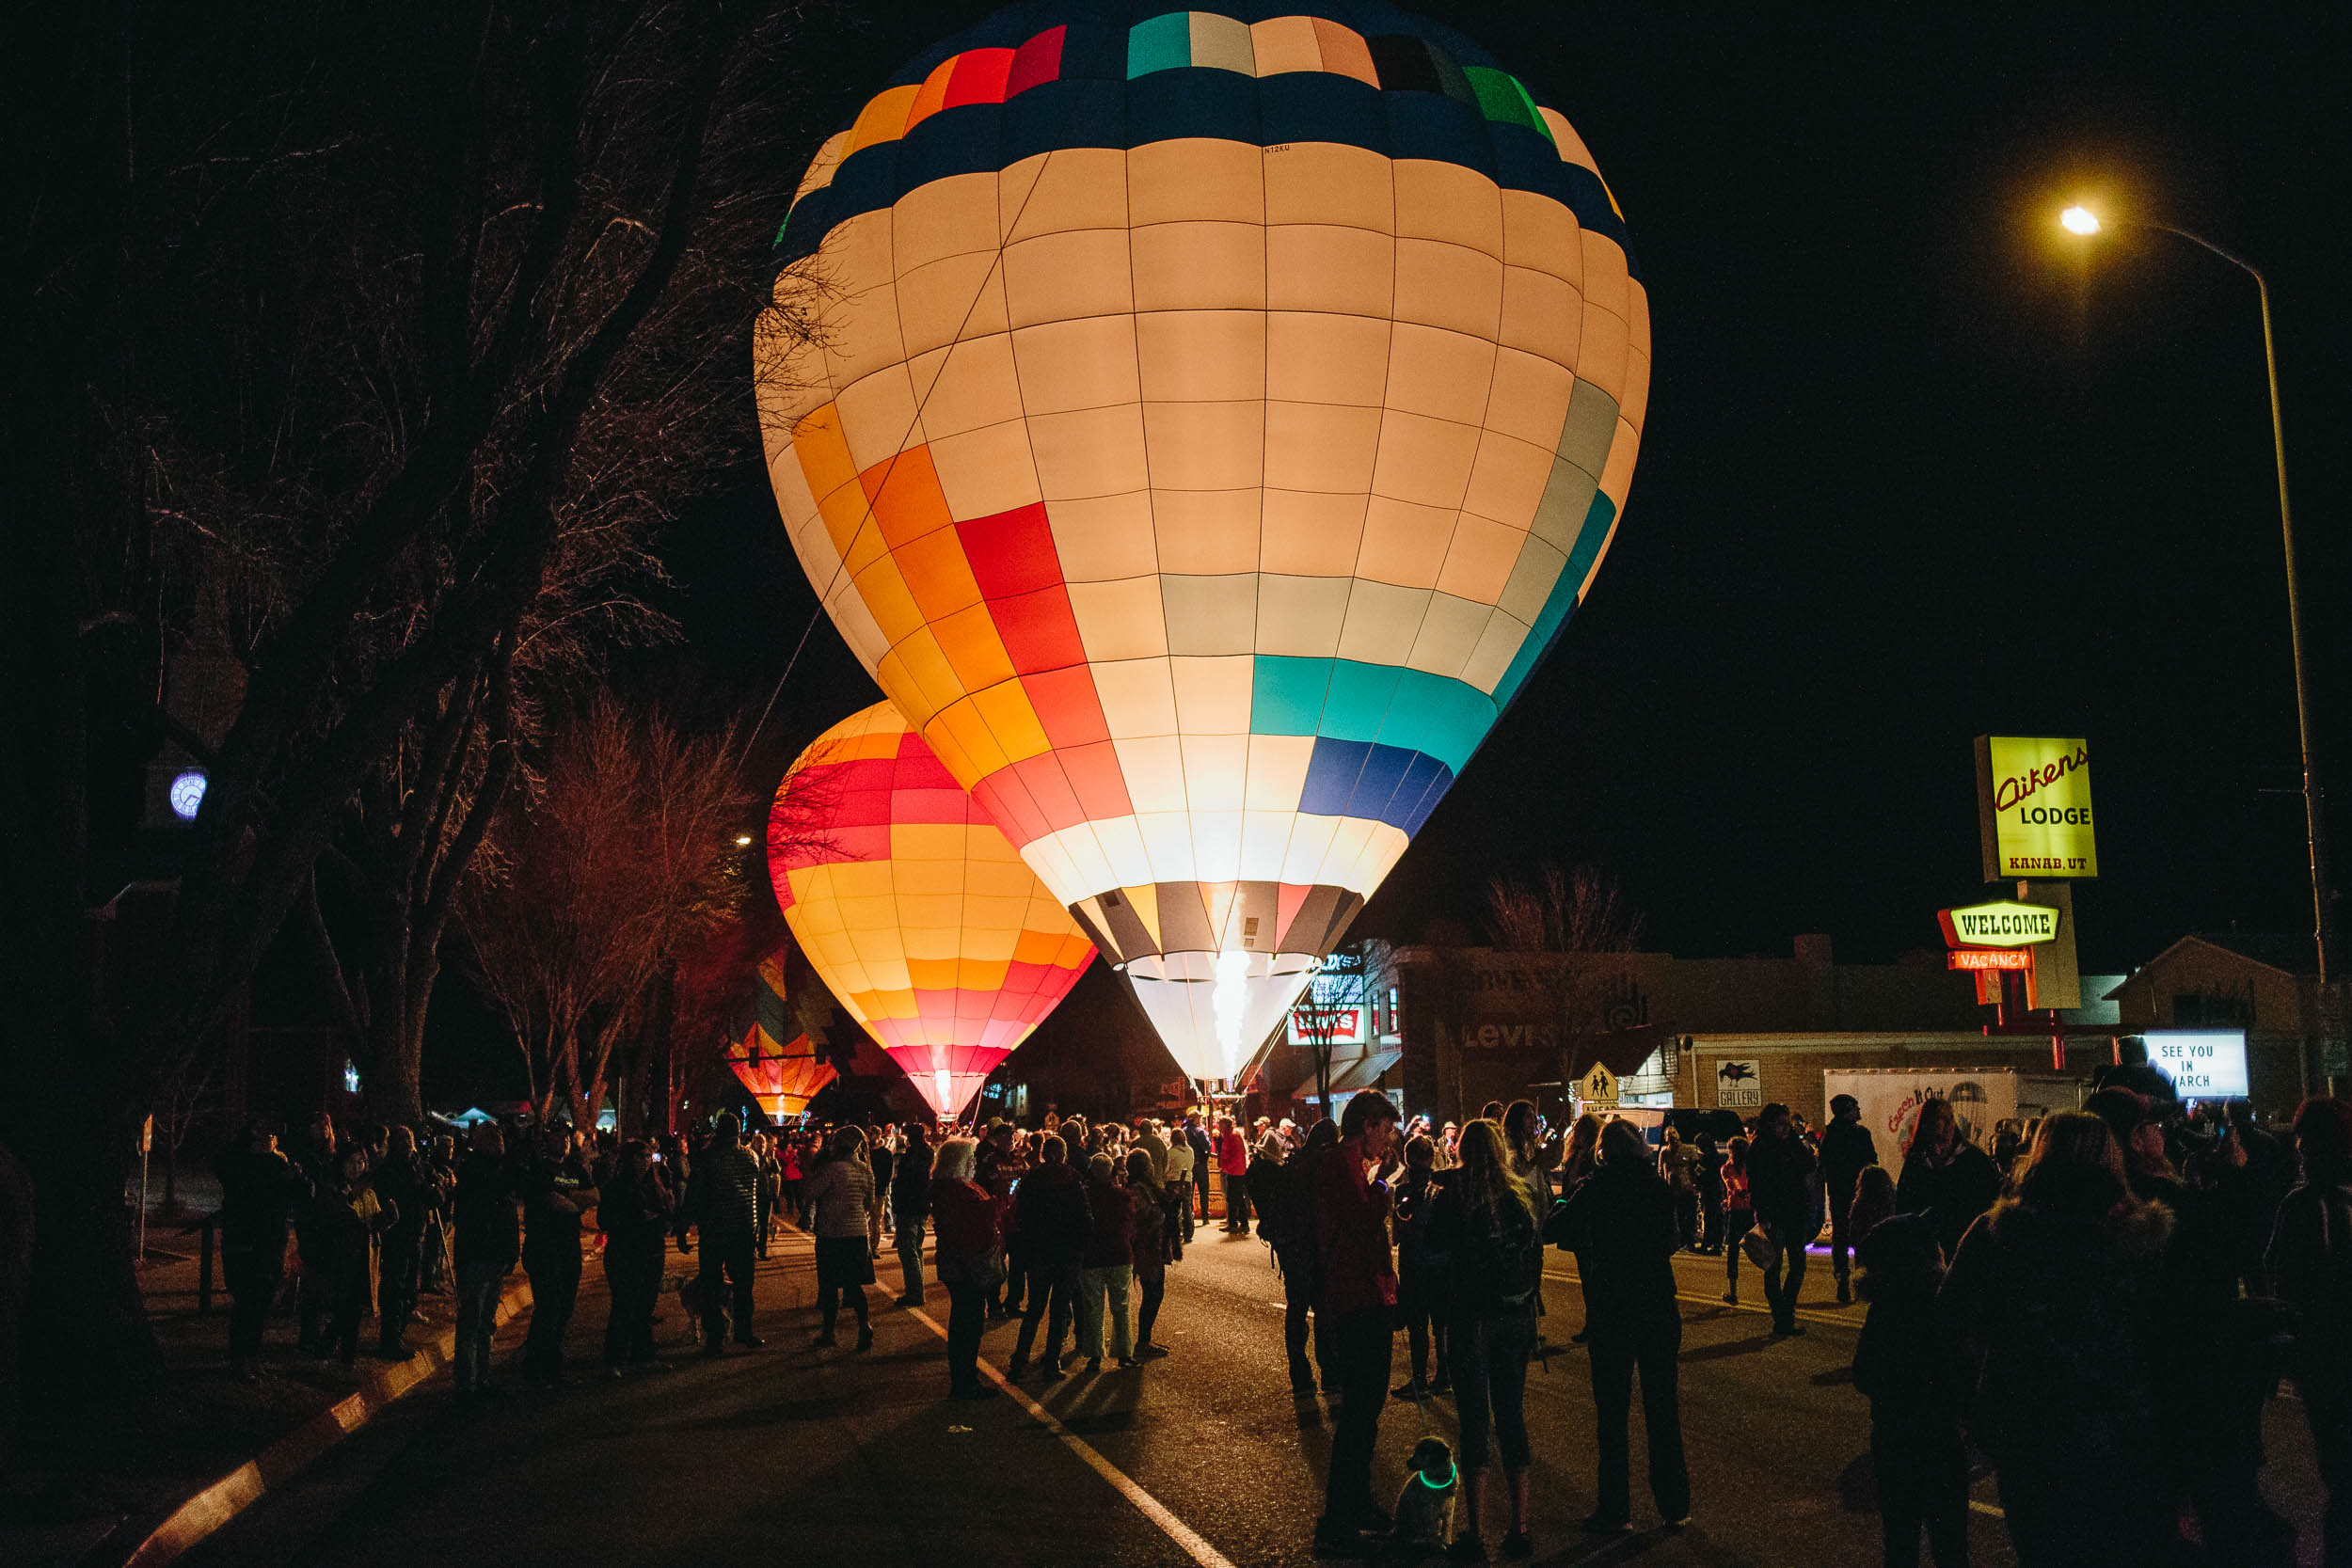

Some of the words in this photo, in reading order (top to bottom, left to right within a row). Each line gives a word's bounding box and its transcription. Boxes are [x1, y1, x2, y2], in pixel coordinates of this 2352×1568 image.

[1995, 747, 2088, 812] Aikens
[2021, 807, 2090, 825] LODGE
[1962, 914, 2050, 935] WELCOME
[1960, 953, 2026, 967] VACANCY
[2161, 1046, 2182, 1057] SEE
[2189, 1046, 2213, 1057] YOU
[2182, 1061, 2193, 1072] IN
[1721, 1091, 1759, 1106] GALLERY
